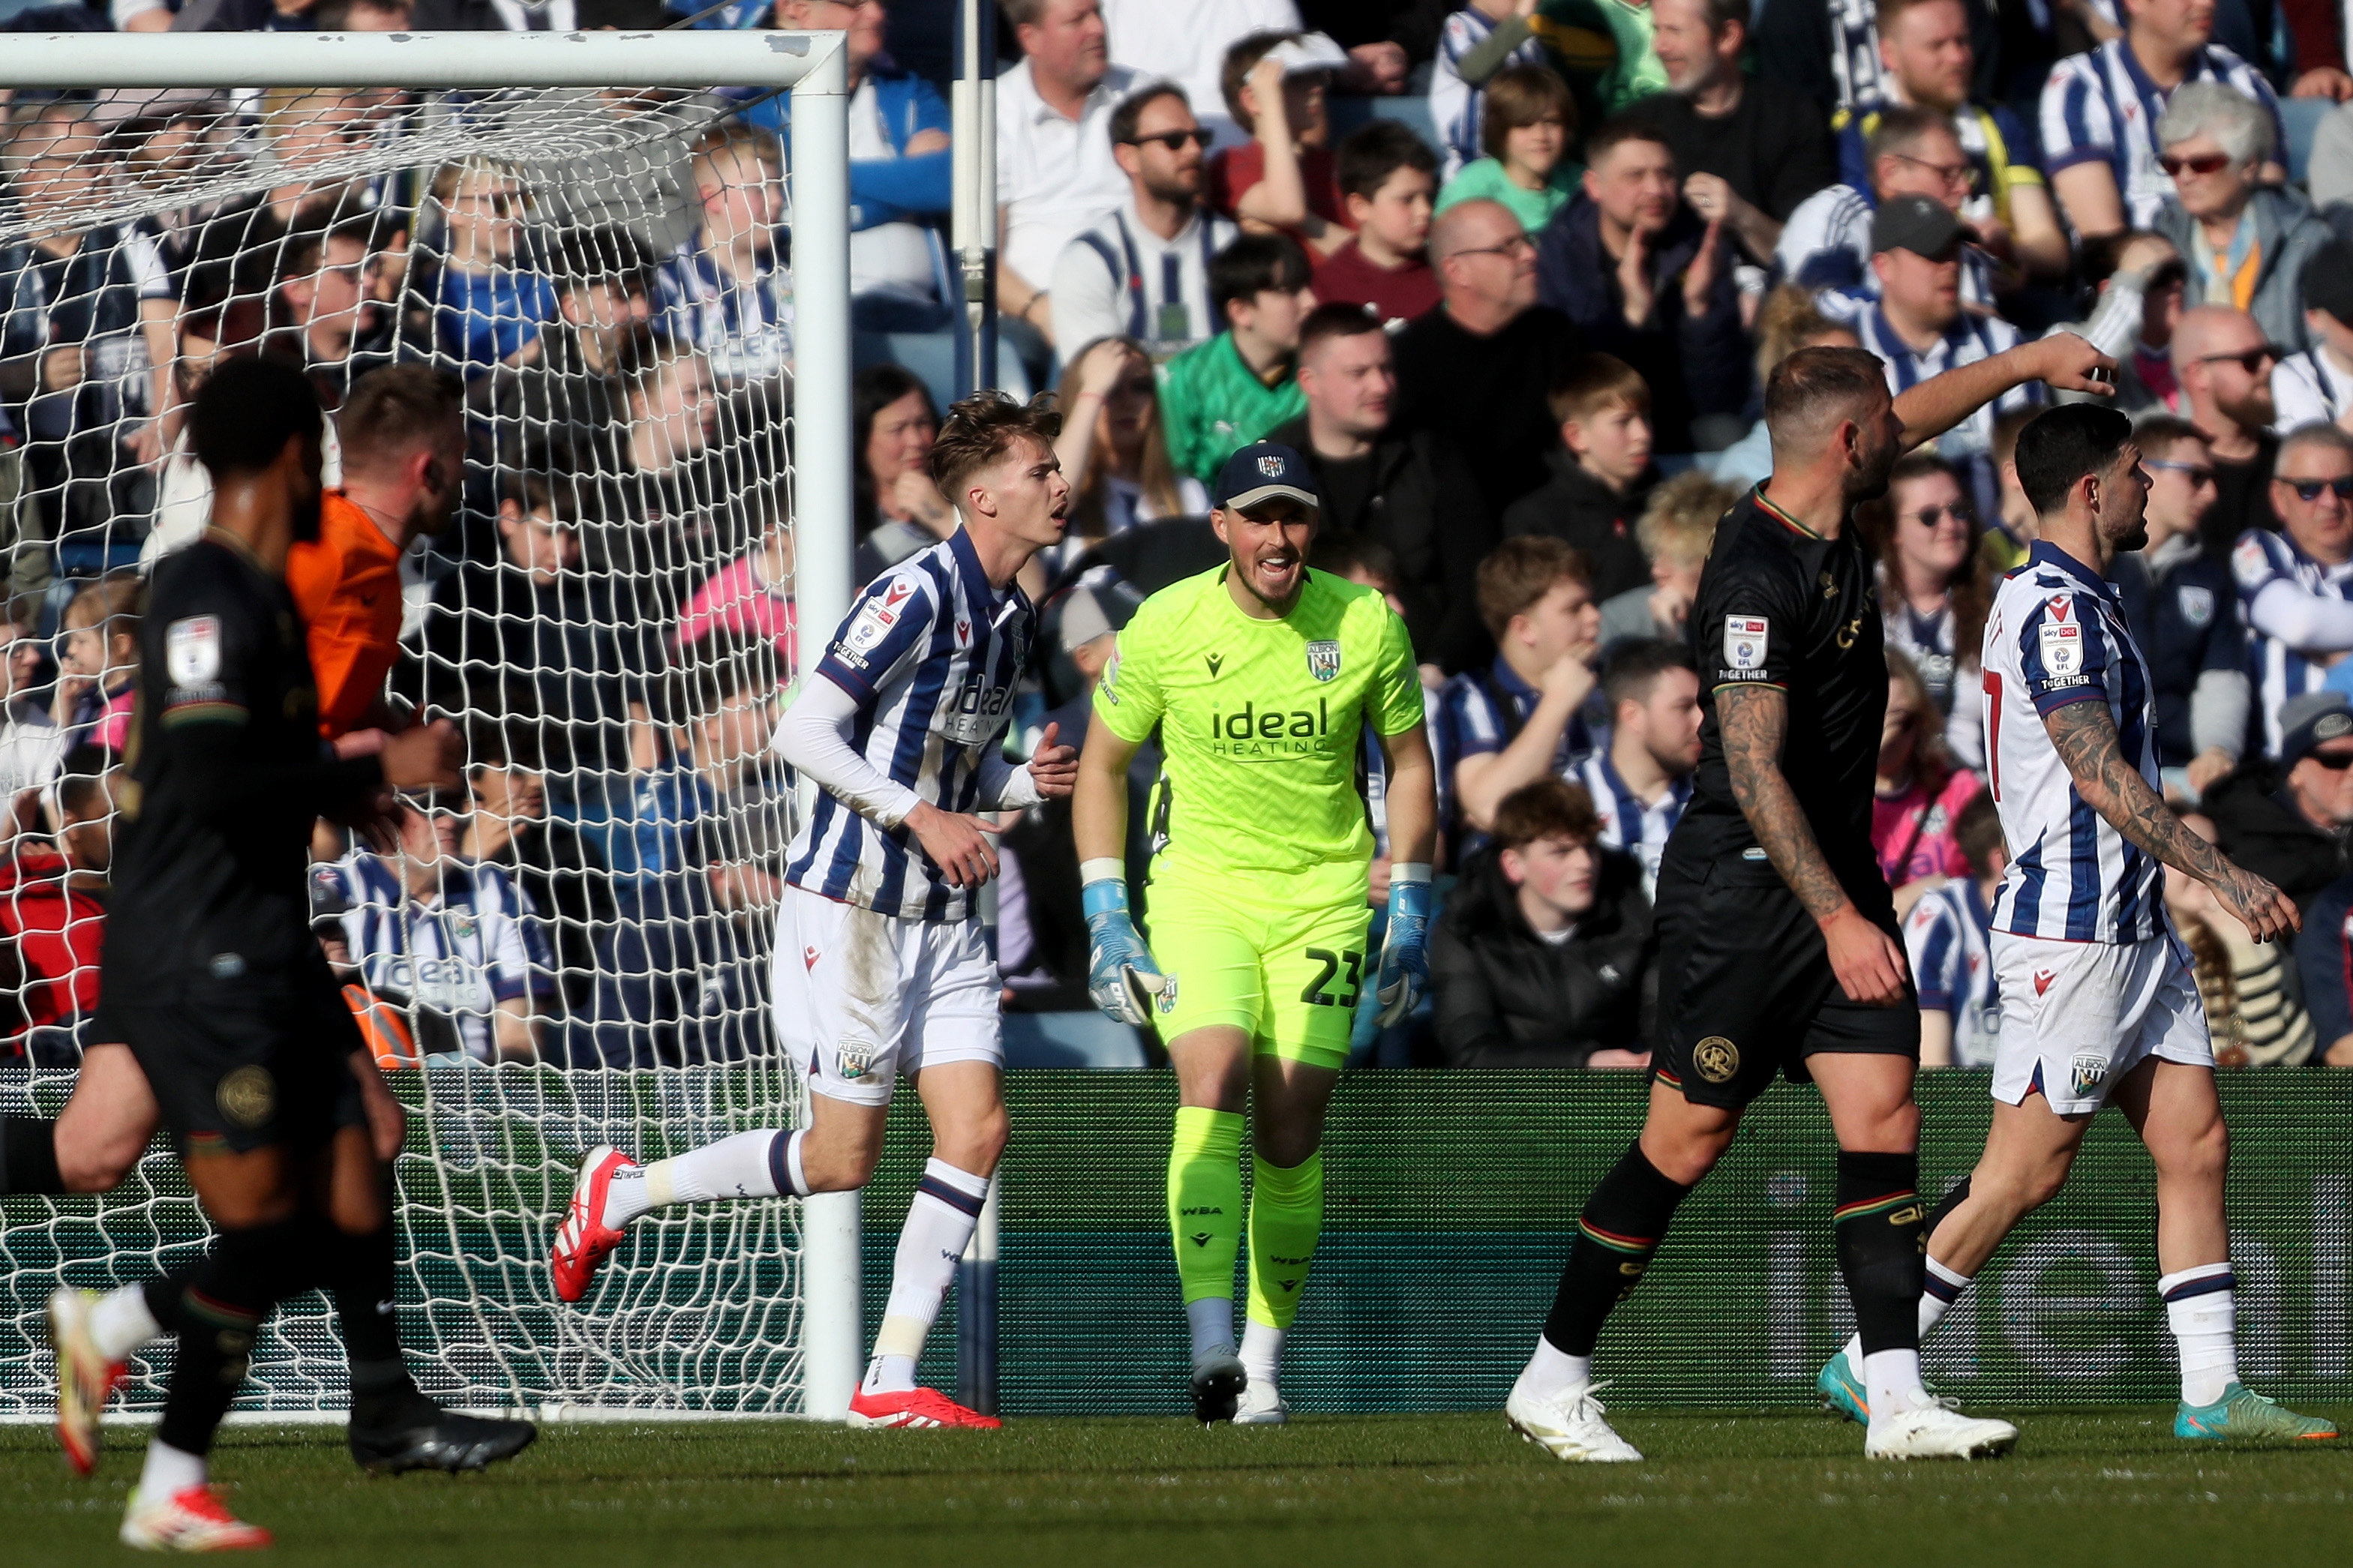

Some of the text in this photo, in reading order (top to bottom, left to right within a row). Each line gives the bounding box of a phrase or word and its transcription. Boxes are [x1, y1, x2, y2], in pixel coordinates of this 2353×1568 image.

[868, 604, 893, 623] sky bet
[1729, 620, 1744, 629] sky
[2044, 628, 2058, 637] sky
[1309, 645, 1338, 653] ALBION
[833, 640, 869, 670] TOGETHER
[1718, 669, 1767, 679] TOGETHER
[2041, 675, 2090, 689] TOGETHER
[949, 674, 1016, 715] ideal
[1213, 697, 1327, 739] ideal
[1213, 739, 1326, 755] HEATING
[1301, 946, 1362, 1007] 23
[839, 1045, 871, 1055] ALBION
[2075, 1060, 2105, 1069] ALBION
[1181, 1206, 1223, 1216] WBA
[1270, 1255, 1310, 1265] WBA
